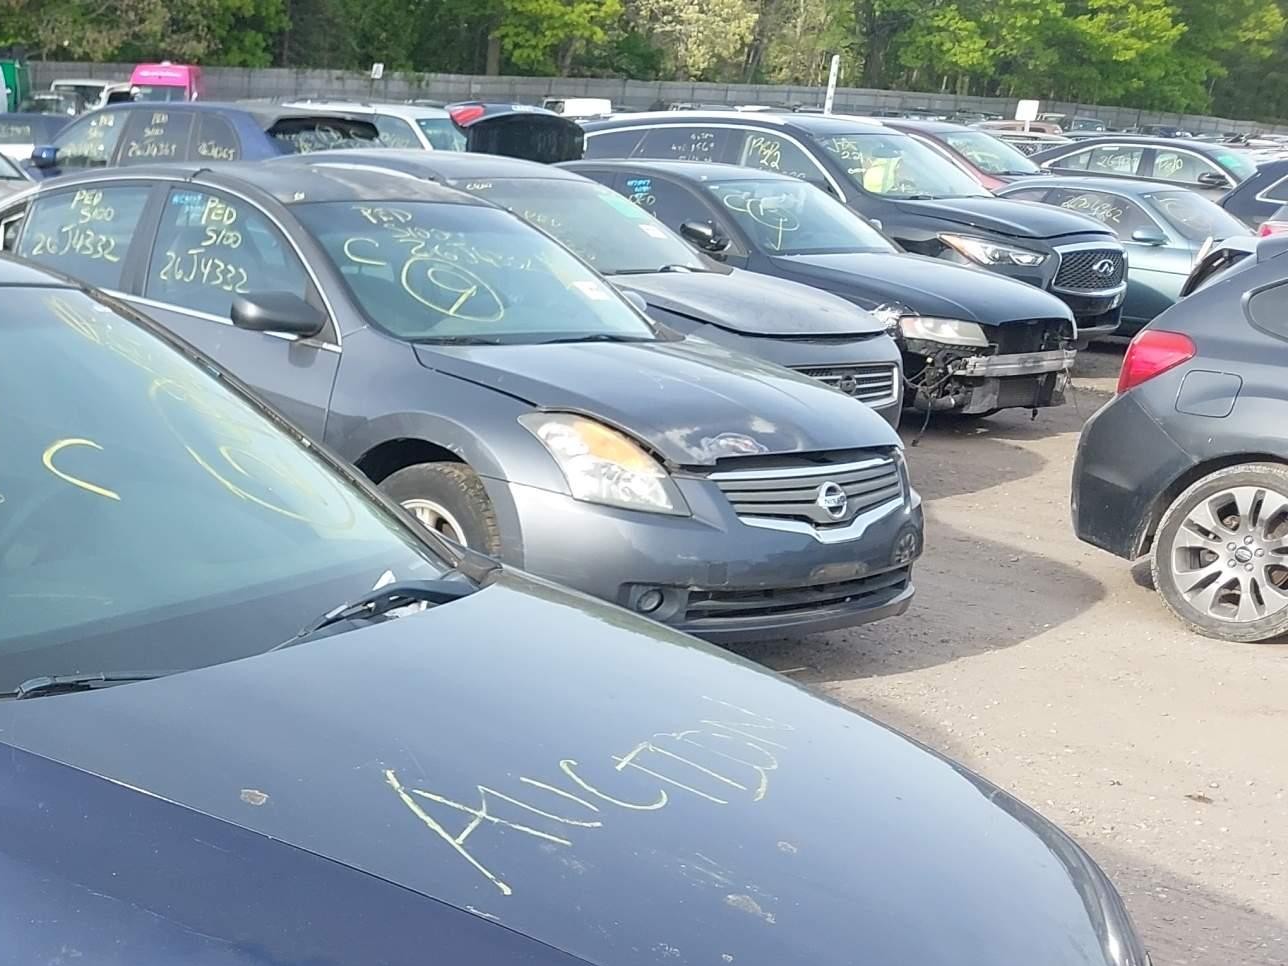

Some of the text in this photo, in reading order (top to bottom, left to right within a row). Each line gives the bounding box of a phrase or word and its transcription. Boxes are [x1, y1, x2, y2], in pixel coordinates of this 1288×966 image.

[69, 189, 104, 209] PED
[201, 196, 238, 226] PED
[32, 222, 121, 263] 26J4332
[160, 247, 251, 294] 26J4332
